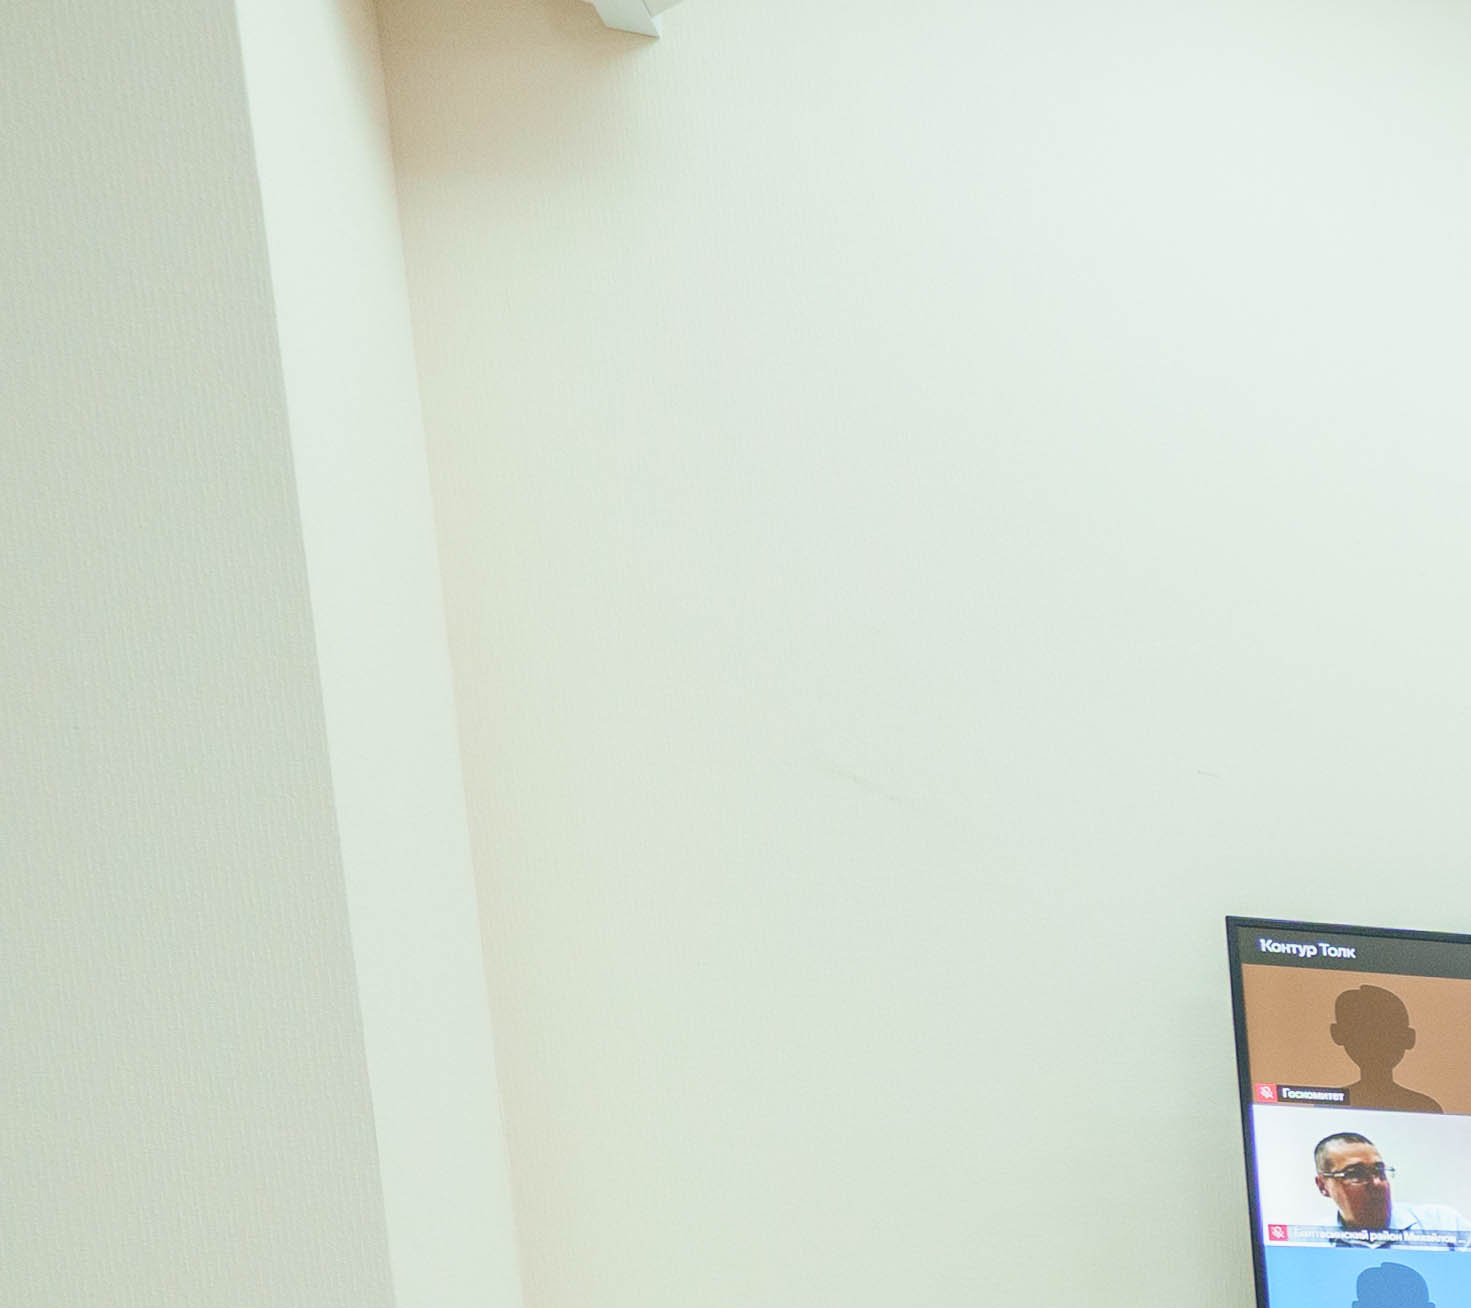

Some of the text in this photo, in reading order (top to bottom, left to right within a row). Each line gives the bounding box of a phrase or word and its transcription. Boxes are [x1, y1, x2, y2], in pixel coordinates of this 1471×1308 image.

[1260, 939, 1356, 959] Контур Толк
[1282, 1088, 1345, 1102] Госкомитет
